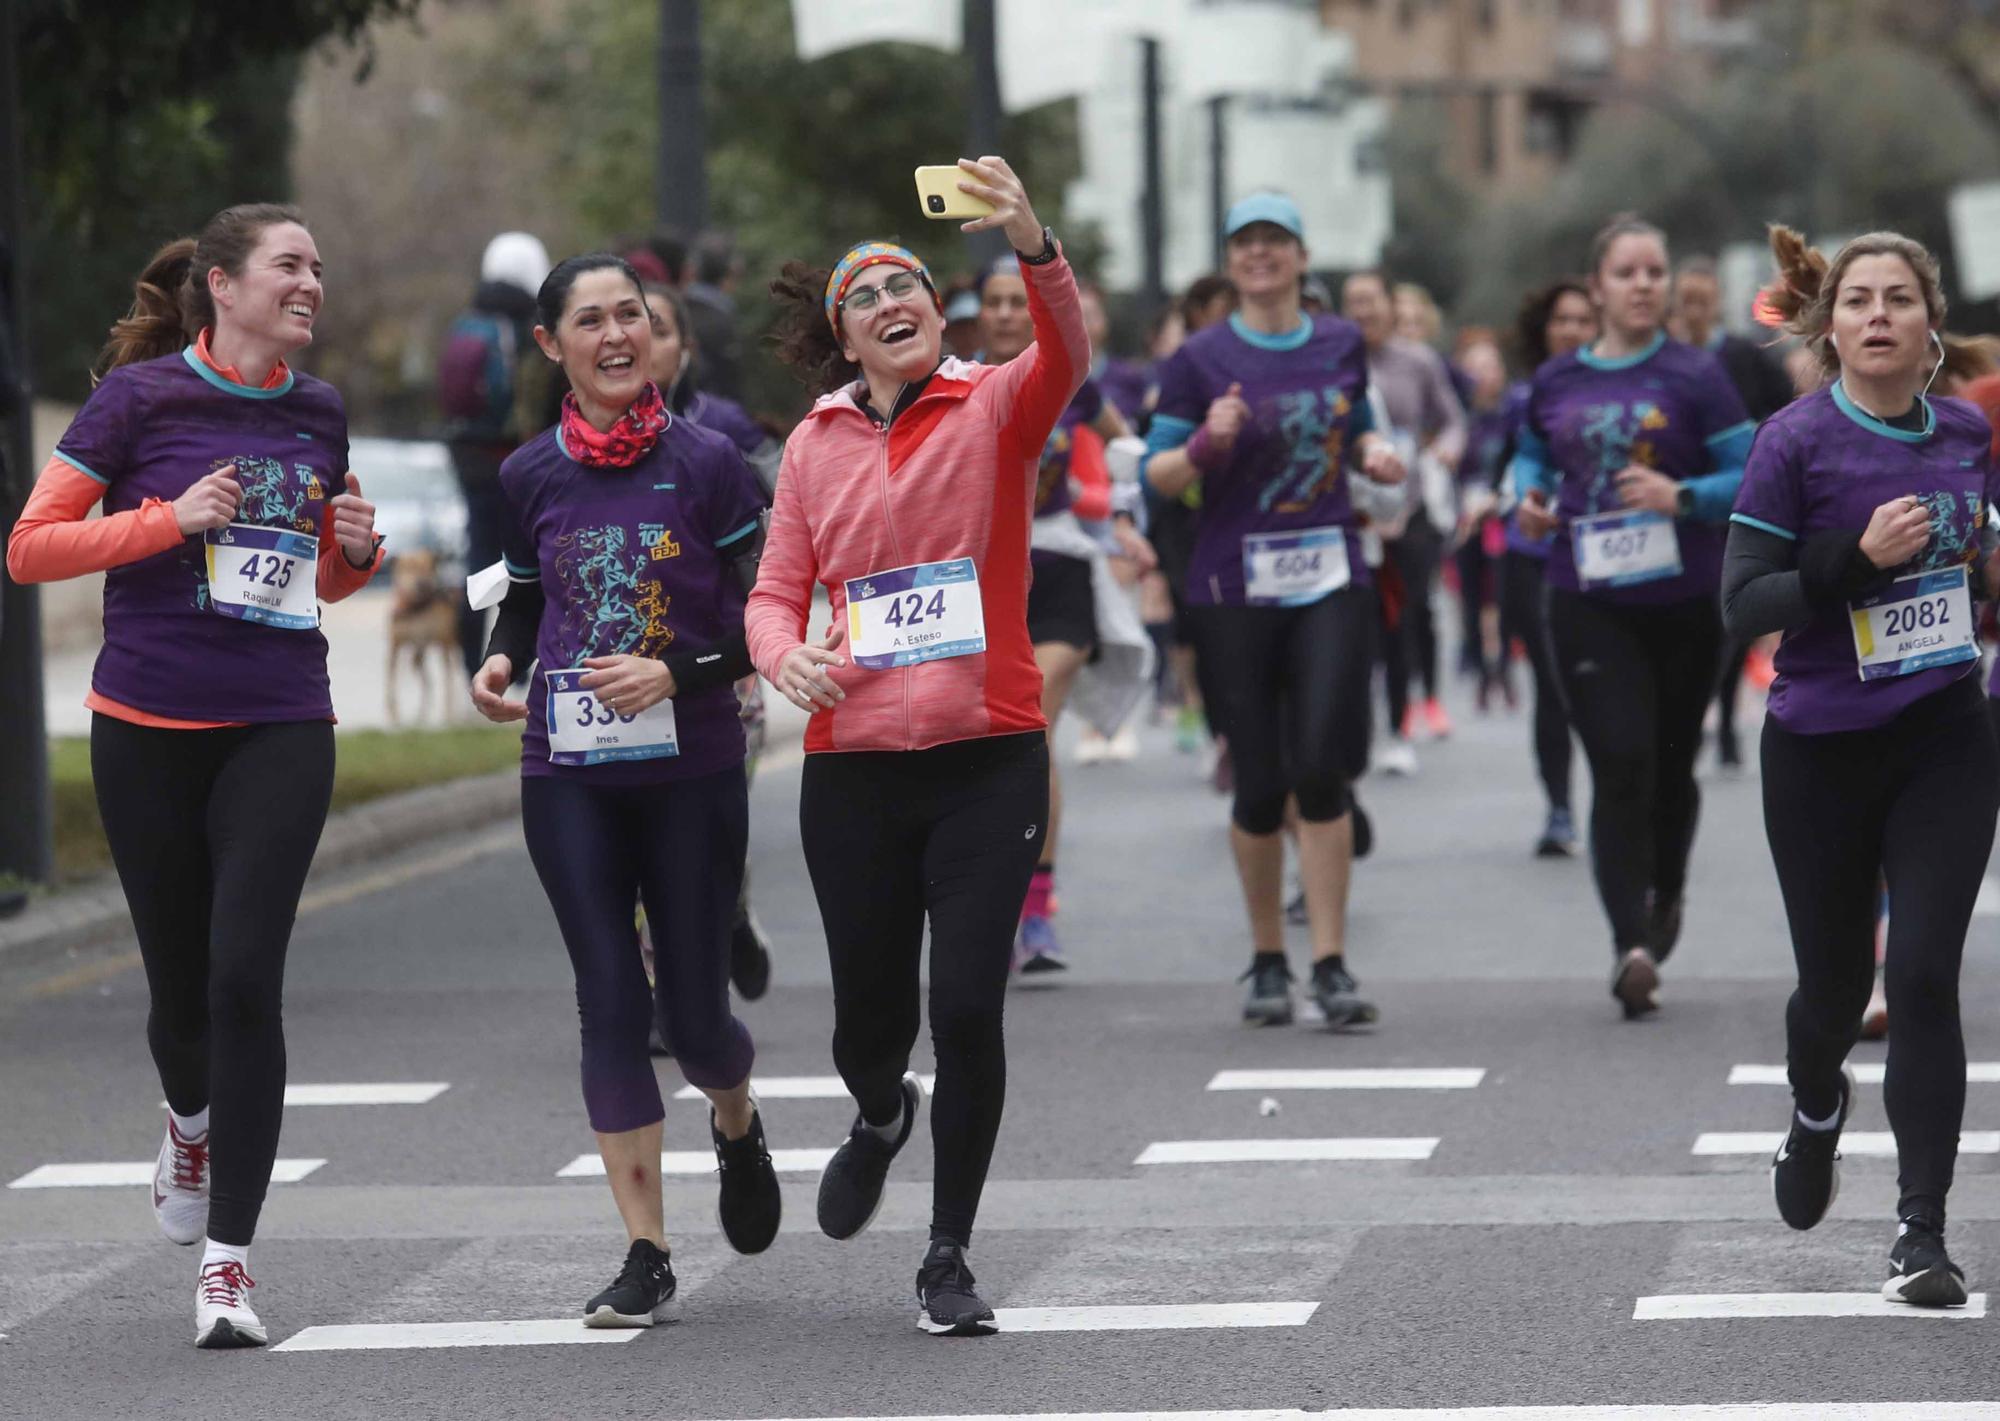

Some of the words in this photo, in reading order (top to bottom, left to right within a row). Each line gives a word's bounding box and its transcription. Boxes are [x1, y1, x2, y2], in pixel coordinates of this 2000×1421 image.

[653, 543, 679, 559] FEM
[1603, 530, 1649, 559] 607
[239, 553, 295, 589] 425
[243, 591, 271, 605] Raquel
[884, 588, 946, 628] 424
[1884, 597, 1950, 638] 2082
[893, 637, 904, 647] A.
[907, 631, 942, 645] Esteso
[1898, 634, 1945, 653] ANGELA
[596, 735, 620, 744] Ines
